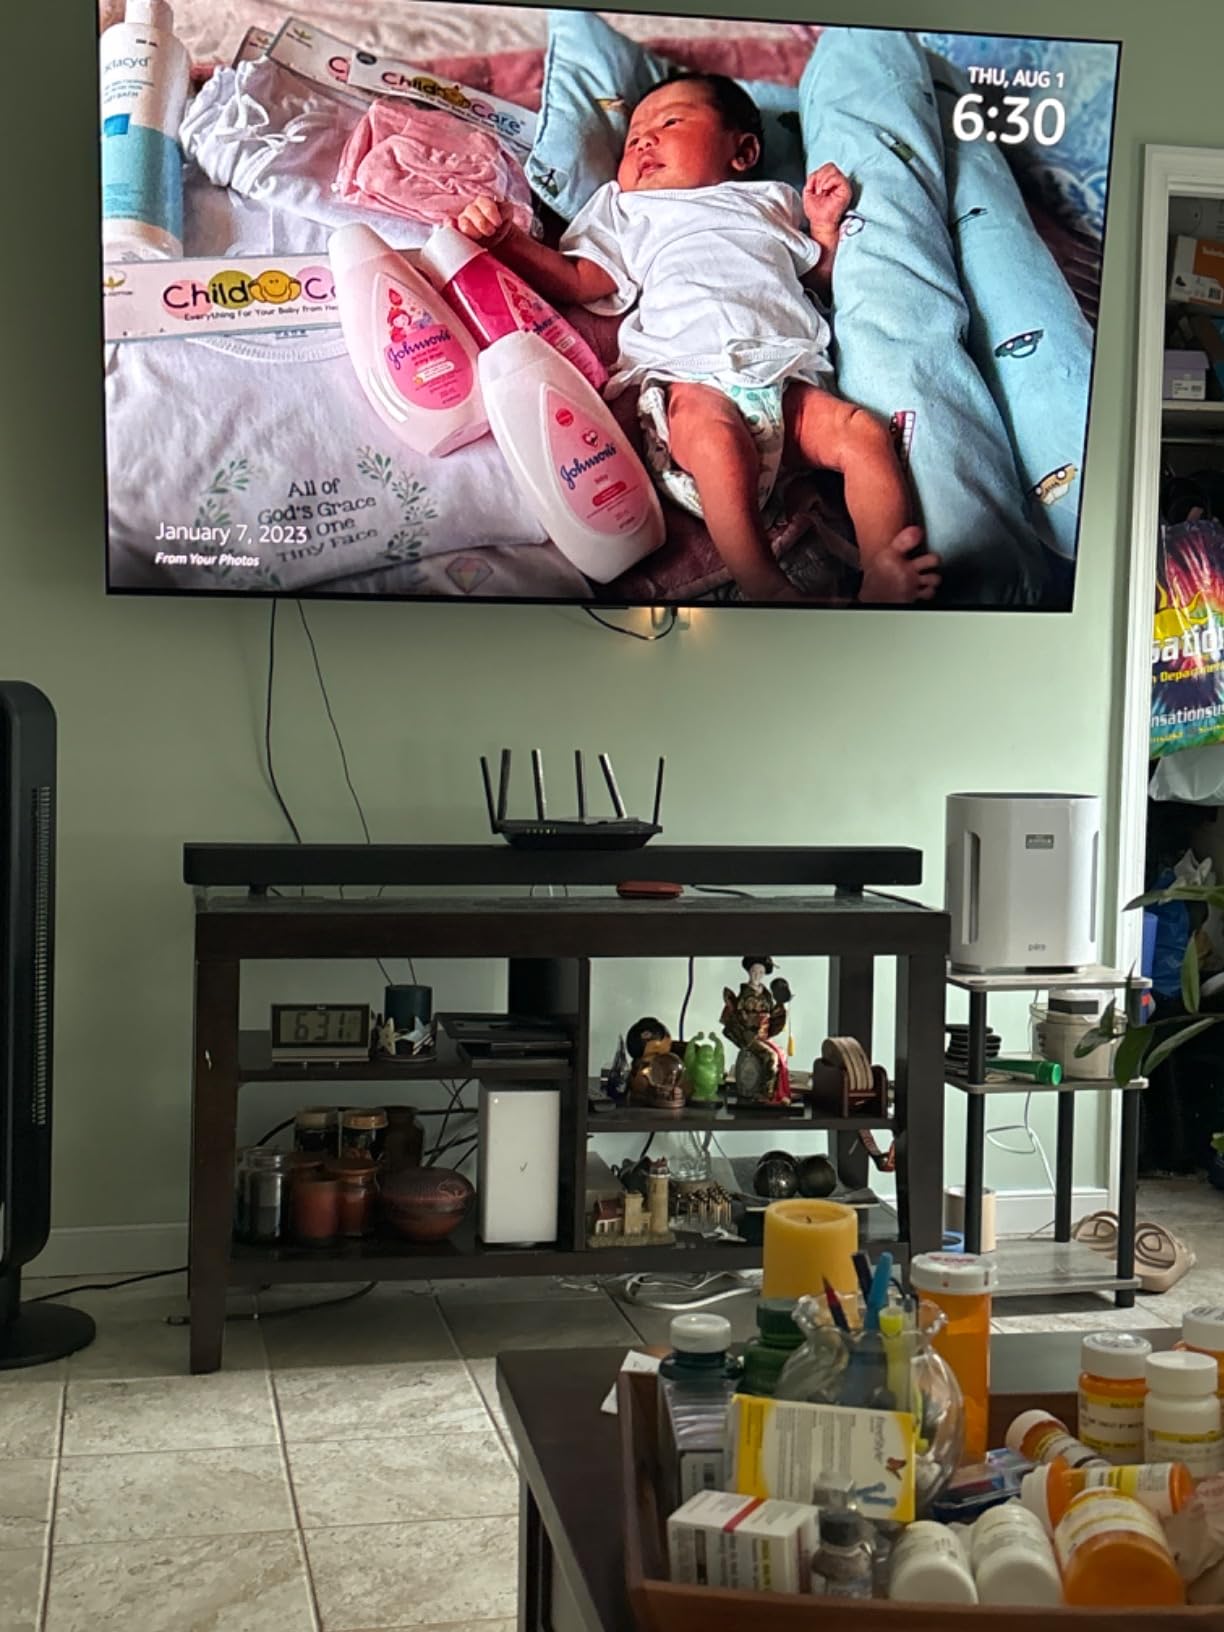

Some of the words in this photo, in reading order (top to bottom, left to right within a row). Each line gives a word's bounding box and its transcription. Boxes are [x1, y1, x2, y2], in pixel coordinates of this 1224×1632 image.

[967, 66, 1009, 88] THU,
[1012, 69, 1050, 88] AUG
[1055, 72, 1065, 89] 1
[952, 93, 1066, 146] 6:30
[163, 279, 249, 309] Child
[288, 480, 317, 498] All
[321, 478, 340, 494] of
[258, 505, 313, 525] God's
[317, 497, 376, 516] Grace
[155, 522, 231, 546] January
[236, 524, 252, 544] 7,
[259, 525, 308, 544] 2023
[316, 519, 356, 536] One
[155, 552, 187, 564] From
[189, 553, 217, 566] Your
[218, 553, 260, 567] Photos
